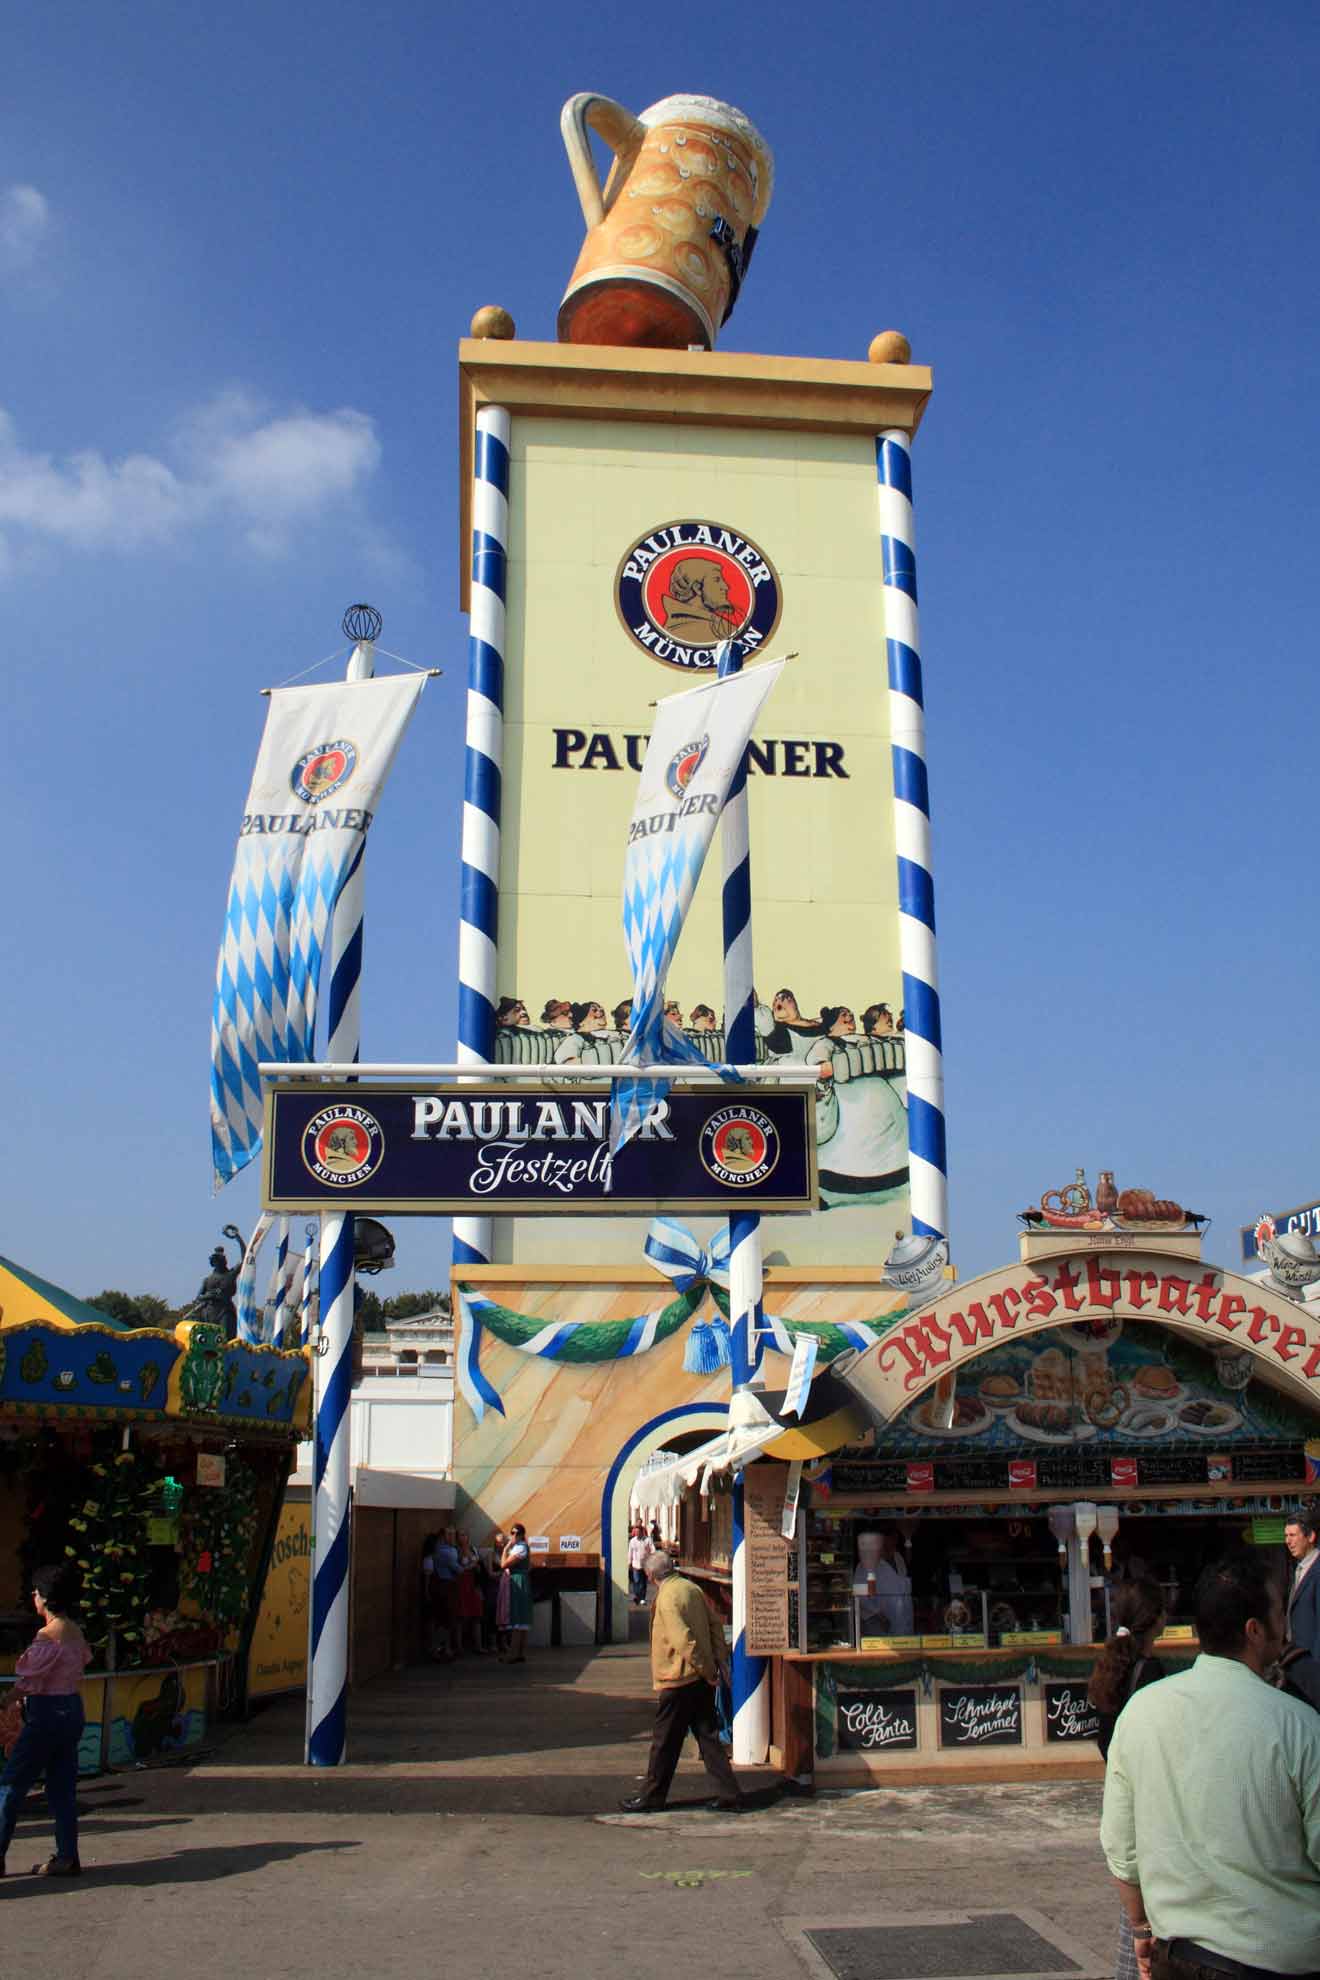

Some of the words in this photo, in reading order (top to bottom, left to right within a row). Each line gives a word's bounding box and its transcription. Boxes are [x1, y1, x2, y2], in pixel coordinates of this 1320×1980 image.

[623, 525, 771, 587] PAULANER
[552, 729, 850, 779] PAUNER
[309, 1107, 379, 1136] PAULANER
[410, 1096, 677, 1141] PAULANR
[705, 1108, 773, 1137] PAULANER
[469, 1141, 614, 1194] Festzelt
[841, 1702, 893, 1732] Cola
[944, 1692, 1019, 1723] Schnitzel-
[862, 1718, 914, 1748] Fanta
[956, 1711, 1018, 1740] Semmel
[1057, 1714, 1101, 1736] Semm
